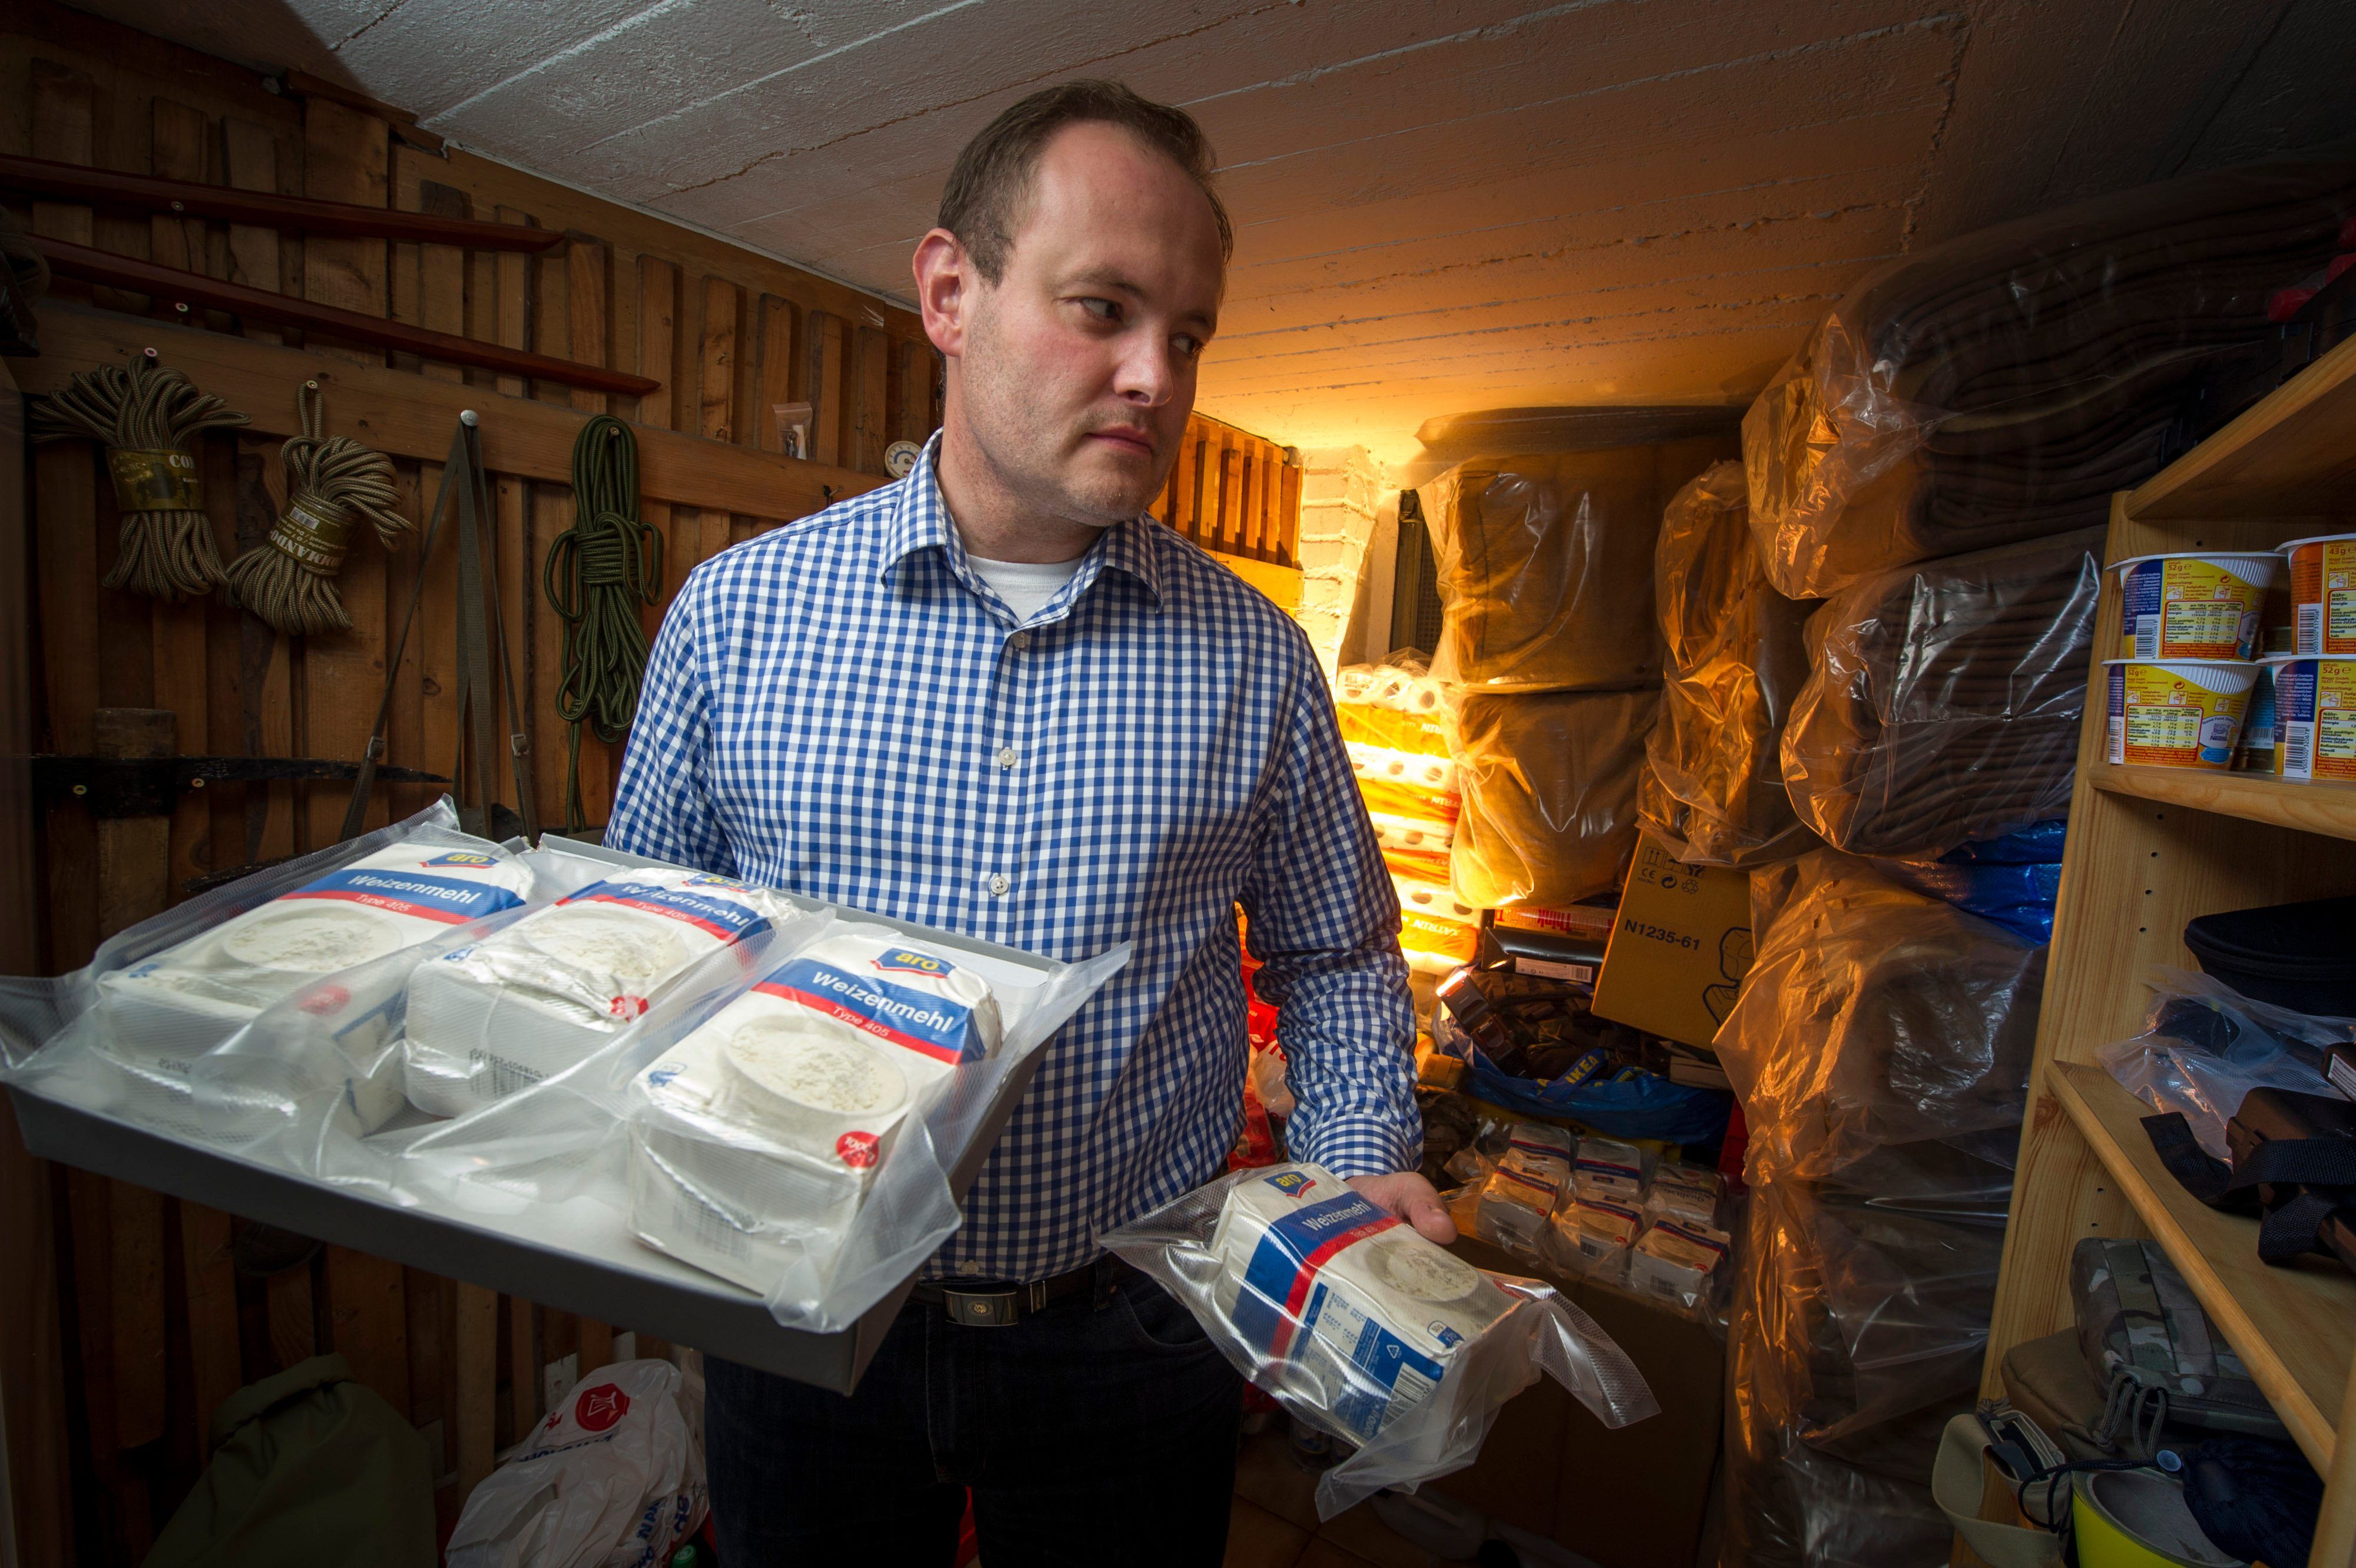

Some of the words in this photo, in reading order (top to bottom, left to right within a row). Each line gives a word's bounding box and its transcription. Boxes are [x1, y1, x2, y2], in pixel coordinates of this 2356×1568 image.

[446, 853, 490, 864] aro
[348, 874, 481, 904] Weizenmehl
[355, 894, 385, 906] Type
[385, 902, 412, 912] 405
[621, 885, 750, 927] Wizenmehl
[636, 901, 663, 912] Type
[665, 909, 690, 920] 405
[1537, 909, 1572, 932] Think
[1624, 919, 1700, 950] N1235-61
[895, 951, 940, 971] aro
[812, 971, 954, 1033] Weizenmehl
[832, 1006, 863, 1026] Type
[863, 1021, 891, 1038] 405
[1564, 1054, 1600, 1084] IKEA
[1275, 1173, 1303, 1187] aro
[1301, 1200, 1372, 1232] Weizenmehl
